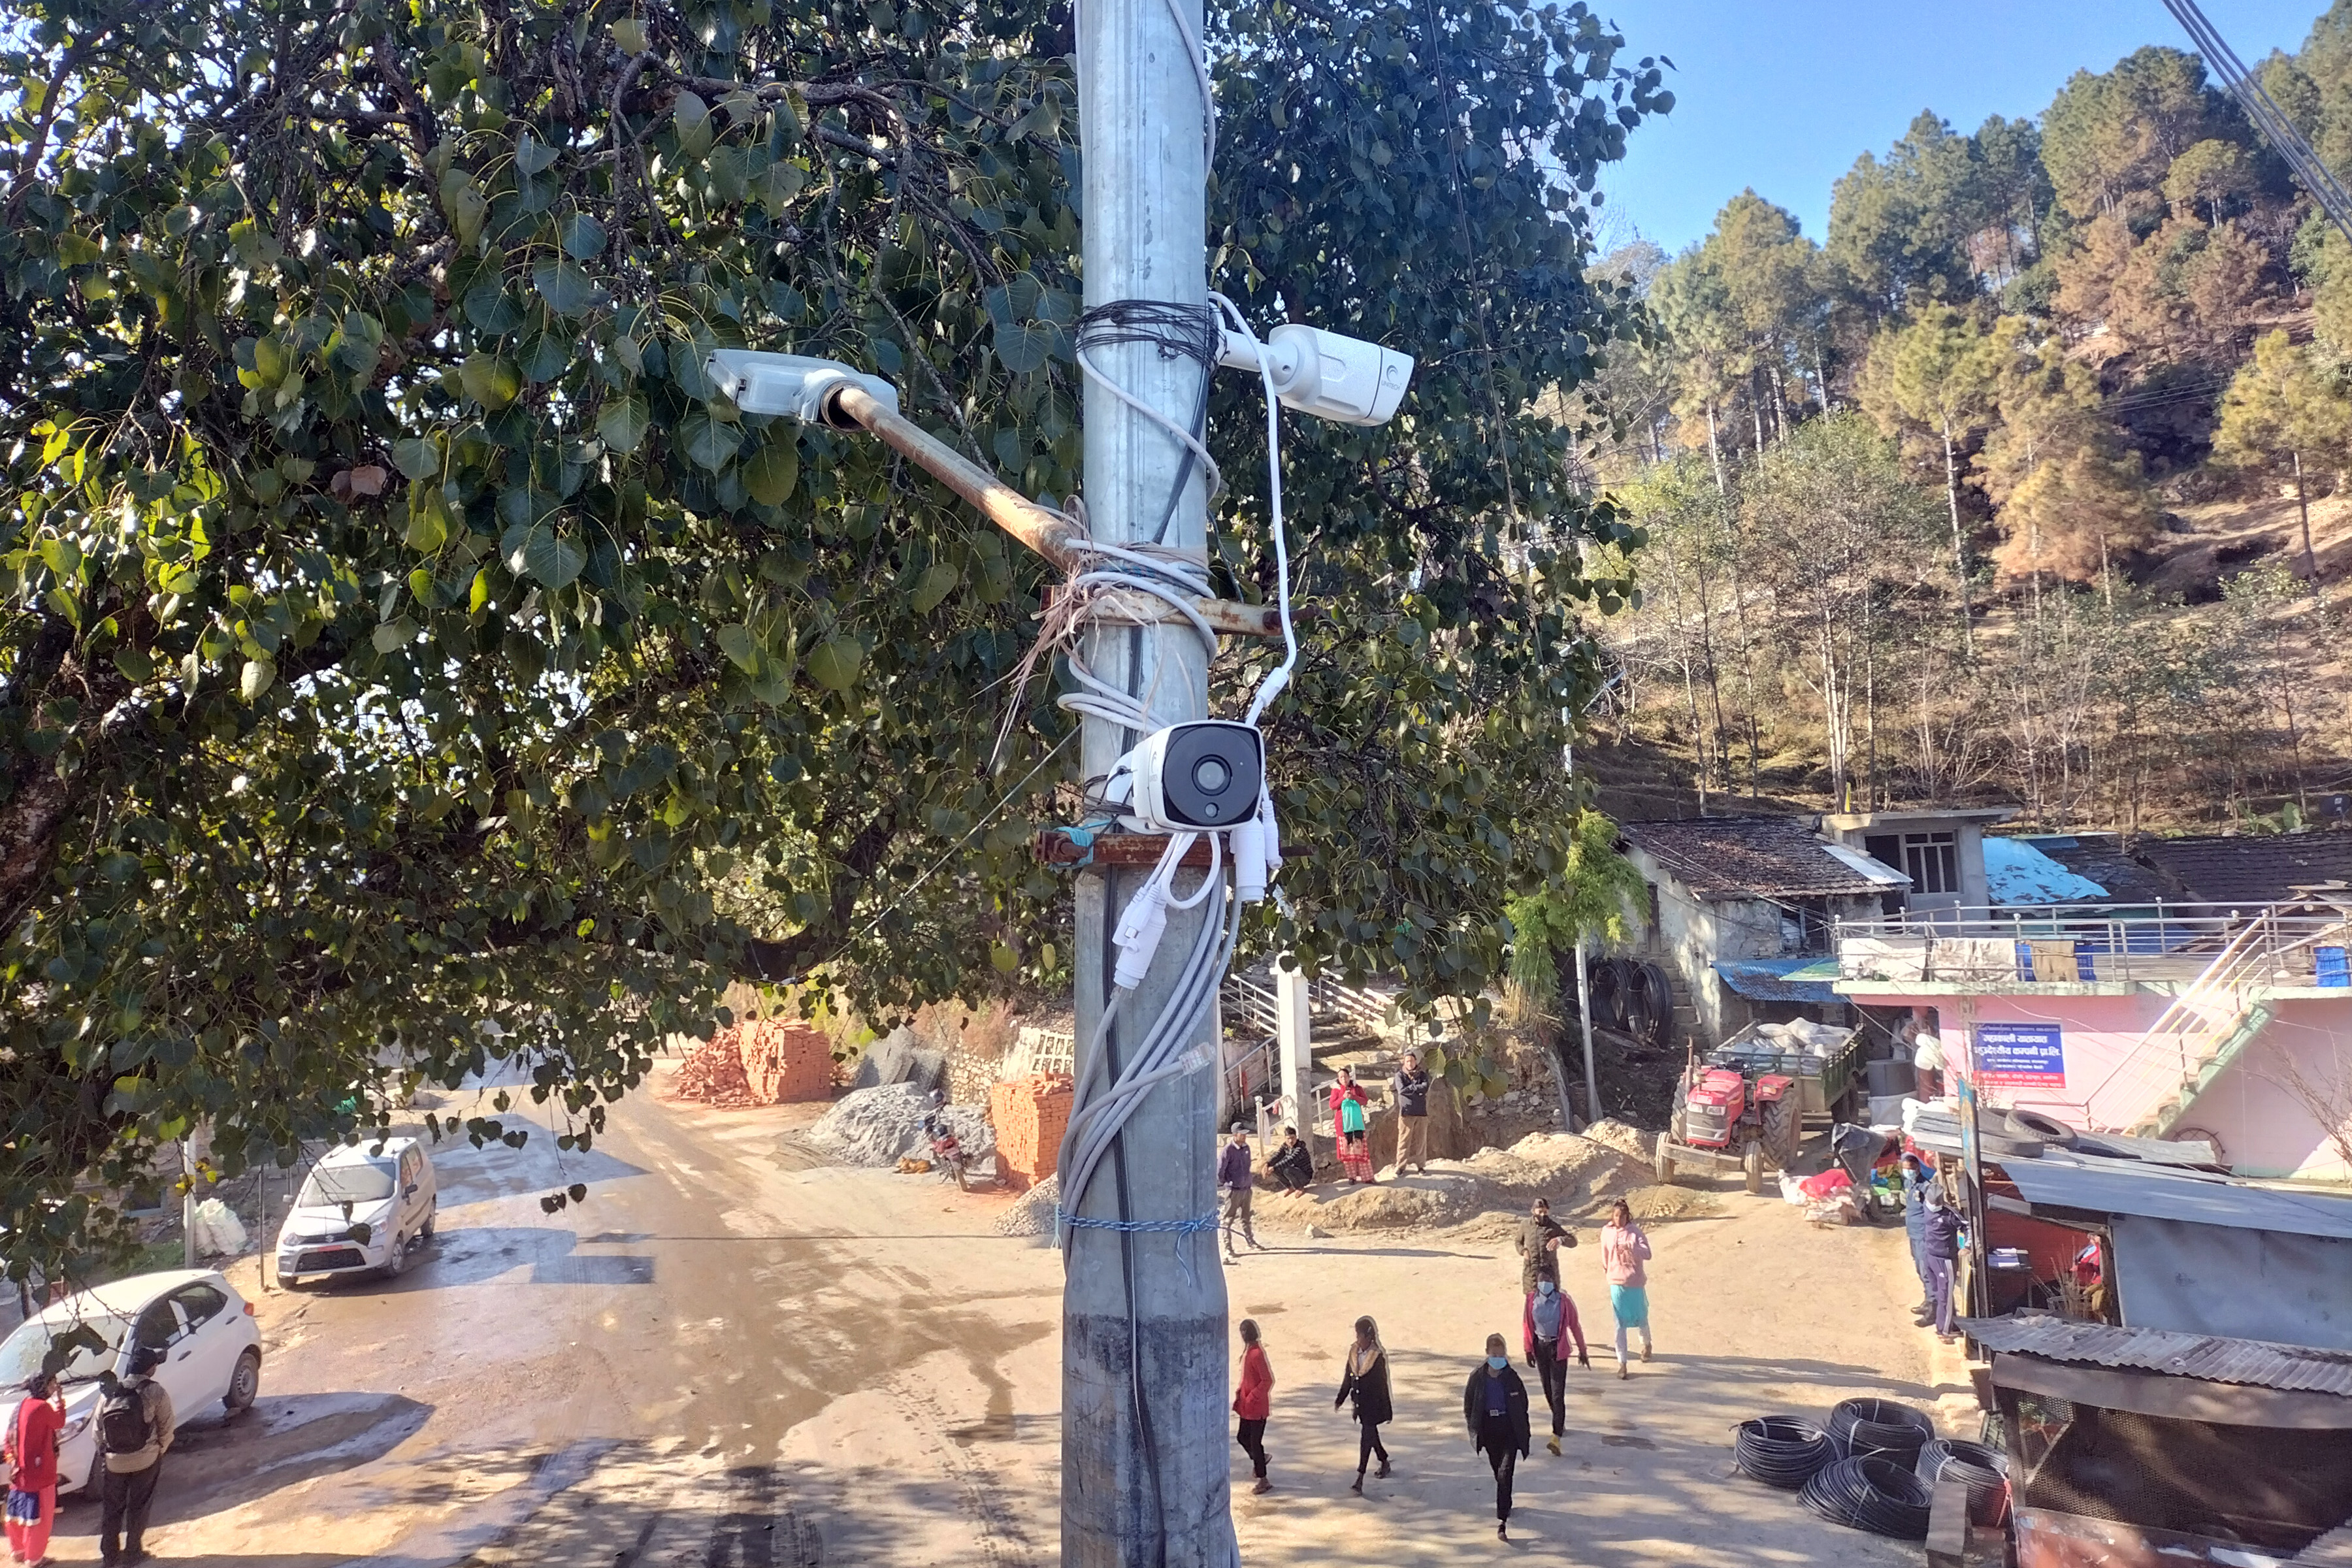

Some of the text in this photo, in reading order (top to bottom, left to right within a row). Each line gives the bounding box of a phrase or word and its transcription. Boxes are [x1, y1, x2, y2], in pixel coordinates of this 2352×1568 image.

[1380, 380, 1401, 391] UNITECH
[2017, 1035, 2048, 1043] यातायात
[2012, 1045, 2038, 1055] कम्पनी
